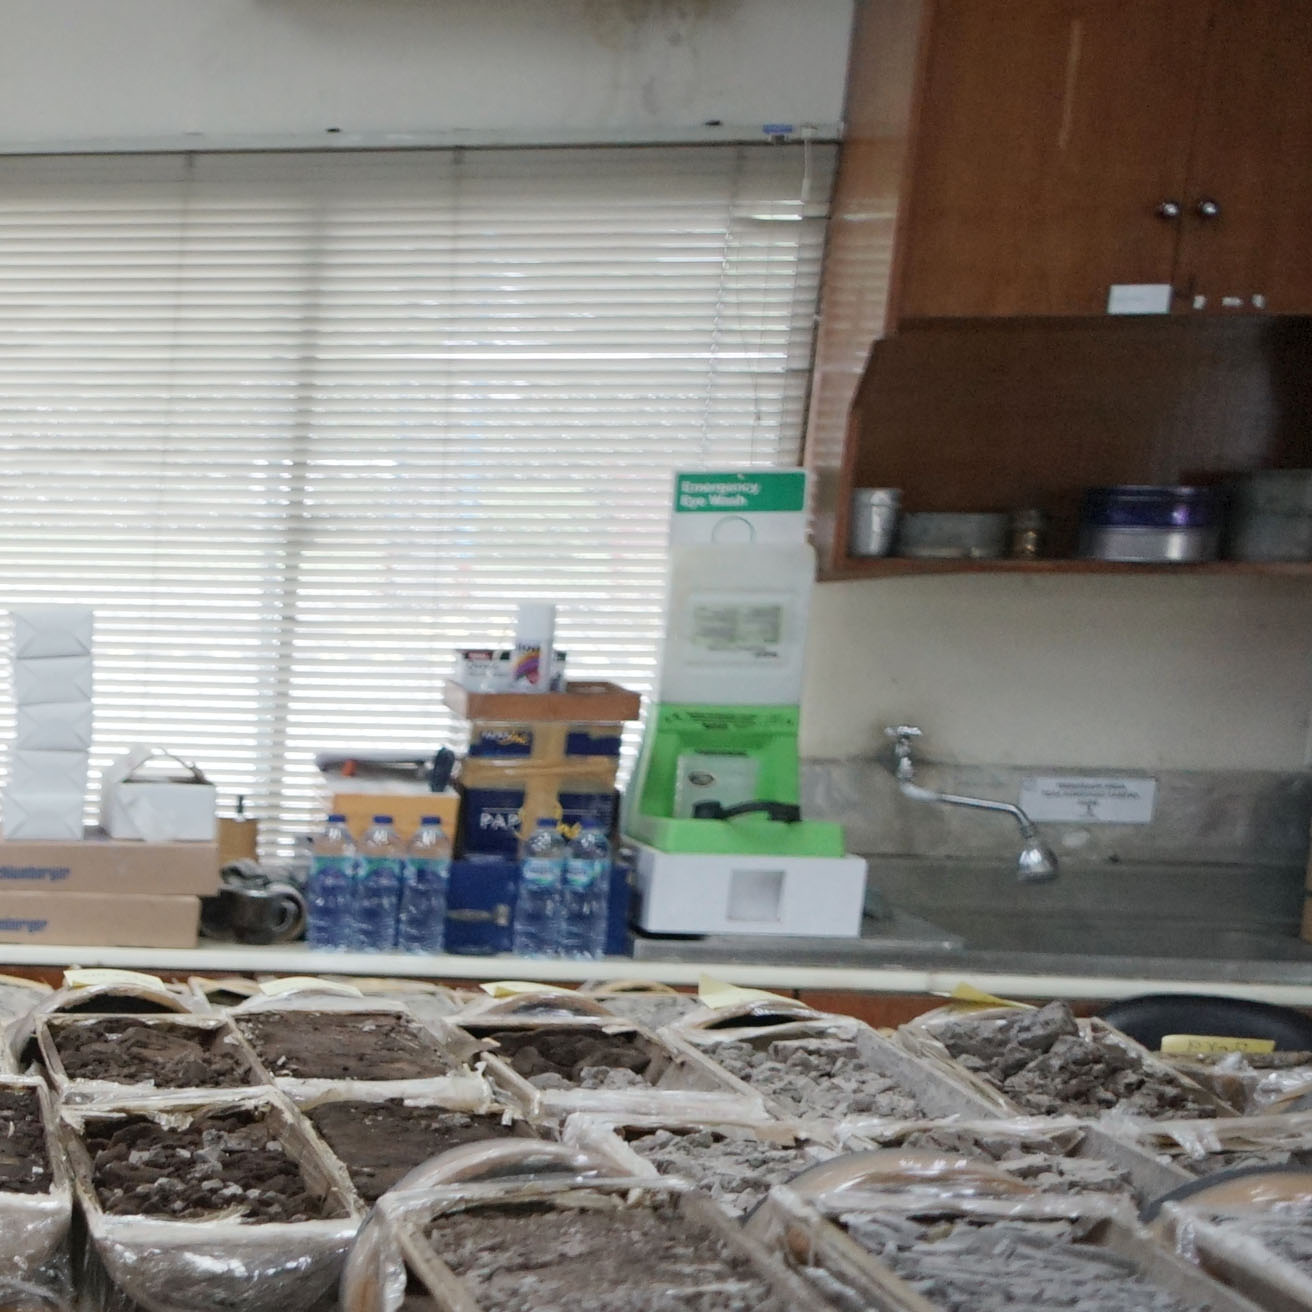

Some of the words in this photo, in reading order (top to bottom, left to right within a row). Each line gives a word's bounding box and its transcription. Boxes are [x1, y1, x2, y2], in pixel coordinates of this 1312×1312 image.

[680, 480, 760, 495] Emergency
[679, 495, 707, 509] Eye
[708, 494, 748, 506] Wash
